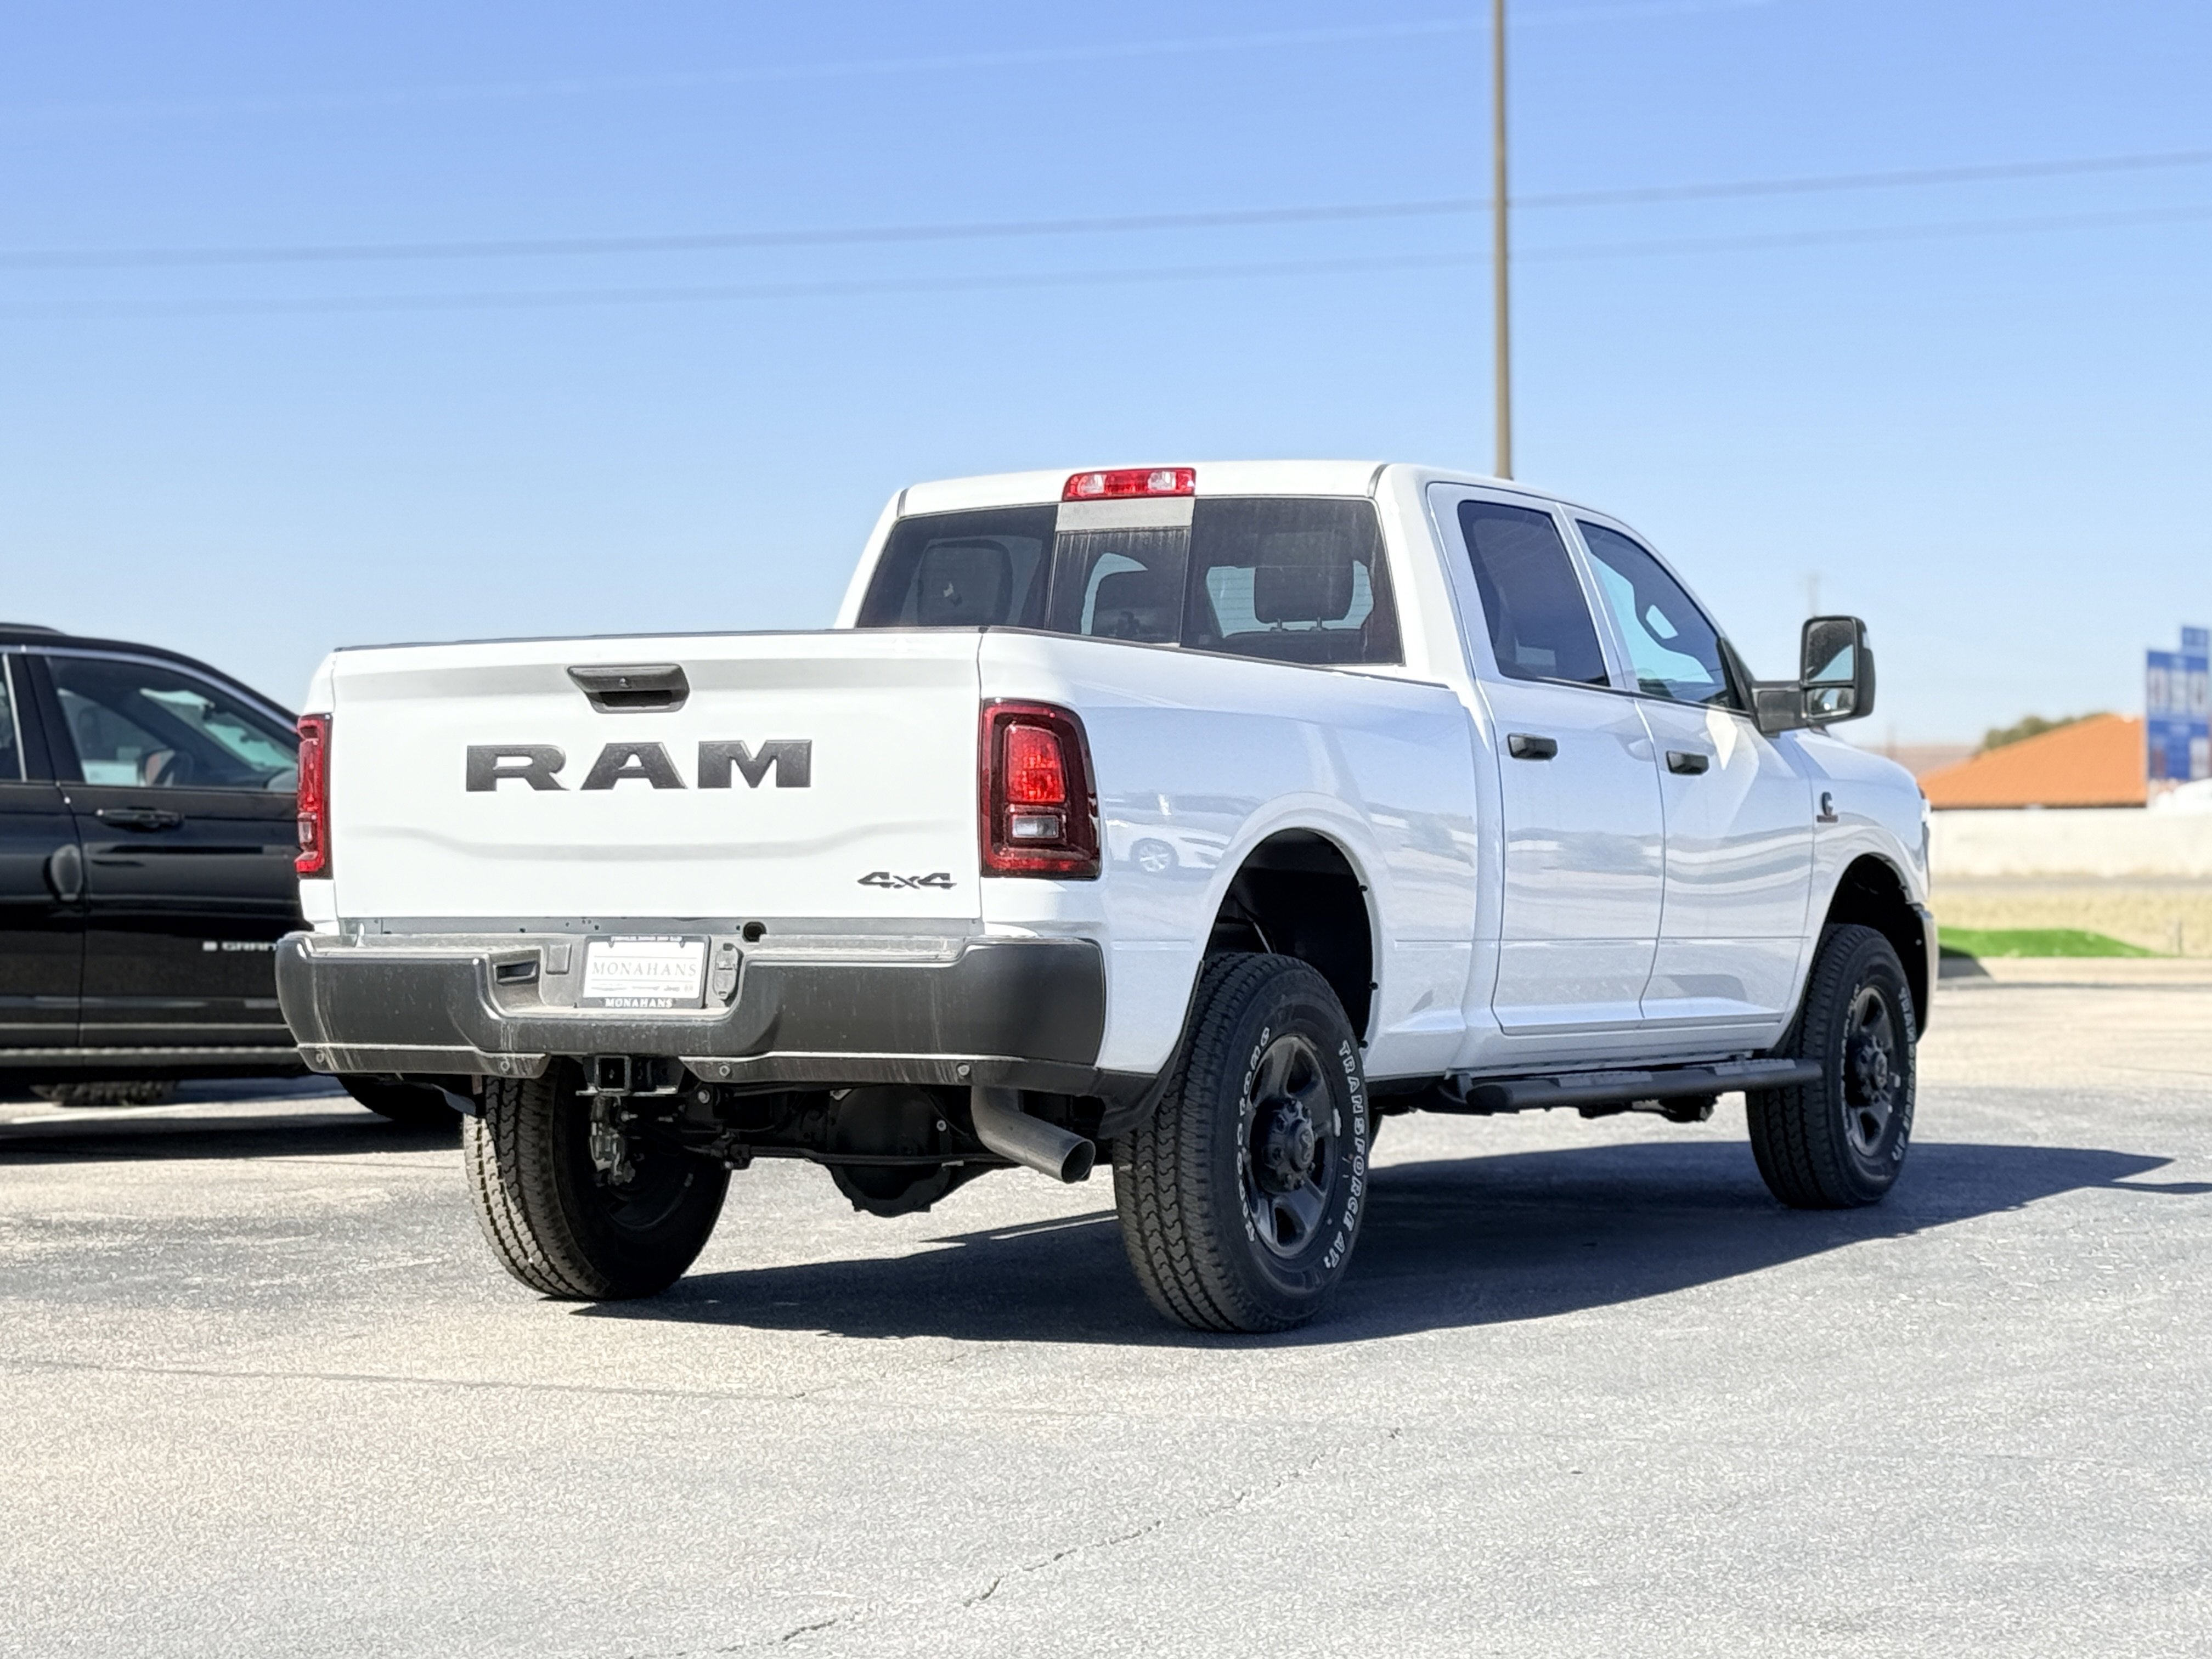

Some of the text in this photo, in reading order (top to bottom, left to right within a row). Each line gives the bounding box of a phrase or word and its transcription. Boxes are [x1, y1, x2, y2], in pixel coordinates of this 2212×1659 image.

[466, 739, 812, 792] RAM
[857, 872, 957, 889] 4x4
[592, 962, 697, 977] MONAHANS
[605, 998, 673, 1008] MONAHANS
[1339, 1040, 1365, 1231] TRANSFORCE
